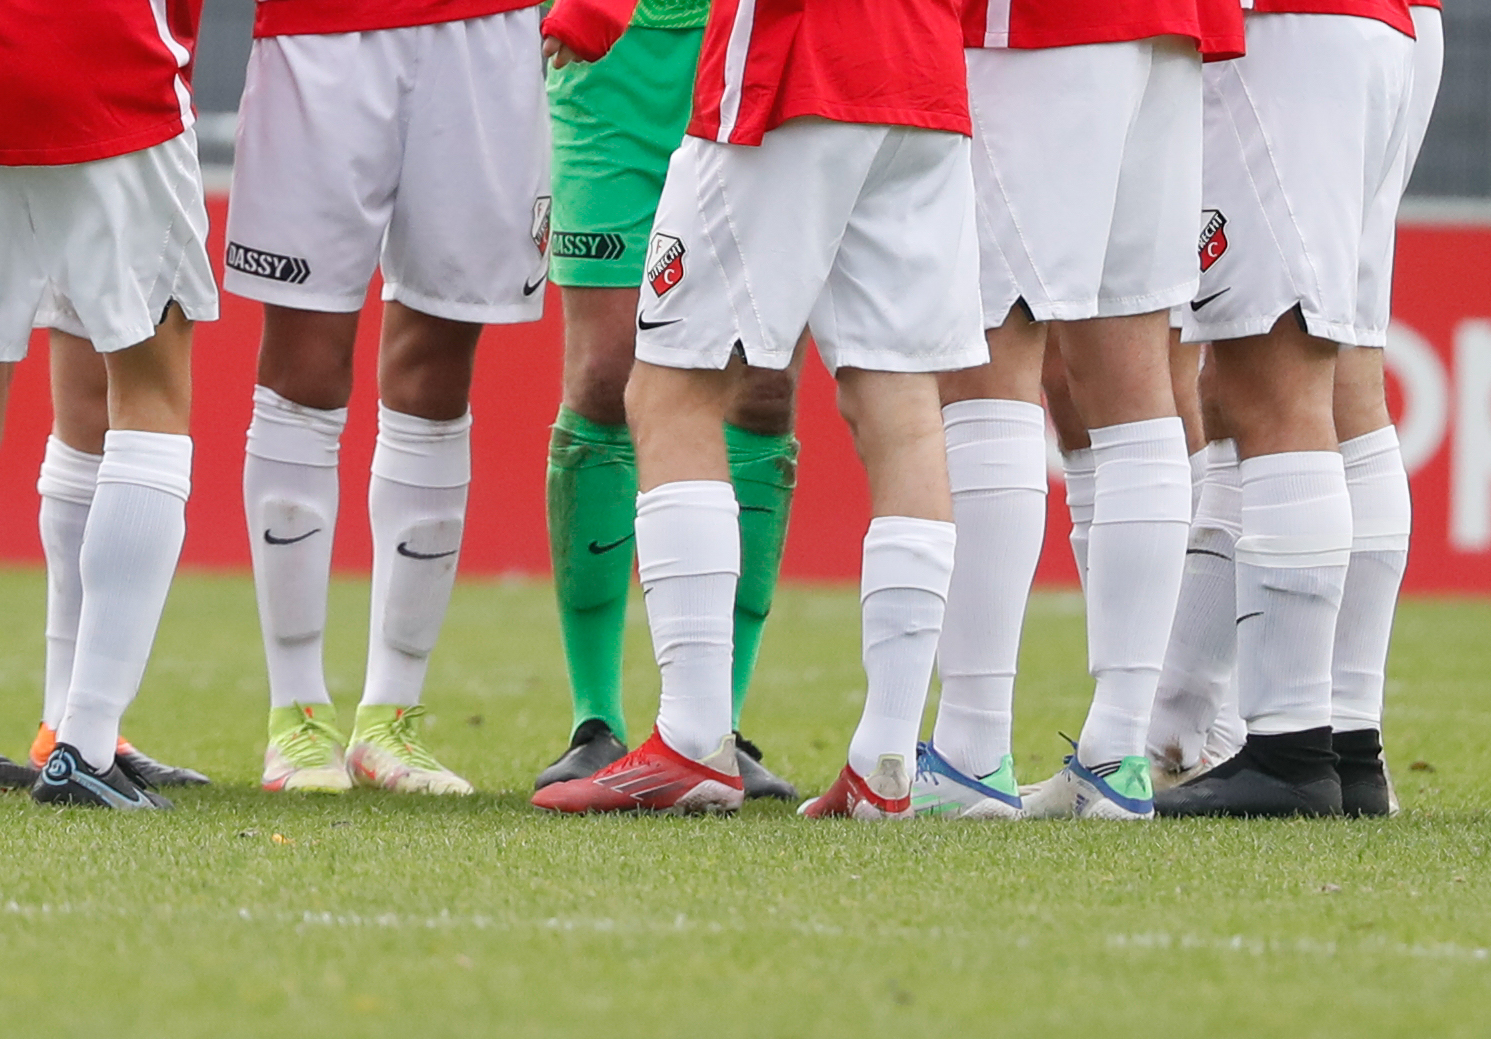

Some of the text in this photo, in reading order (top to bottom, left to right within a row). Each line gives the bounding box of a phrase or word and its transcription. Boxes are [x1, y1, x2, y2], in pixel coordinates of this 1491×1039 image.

[229, 245, 287, 277] DASSY
[649, 242, 682, 281] UTRECHT
[664, 269, 675, 285] C
